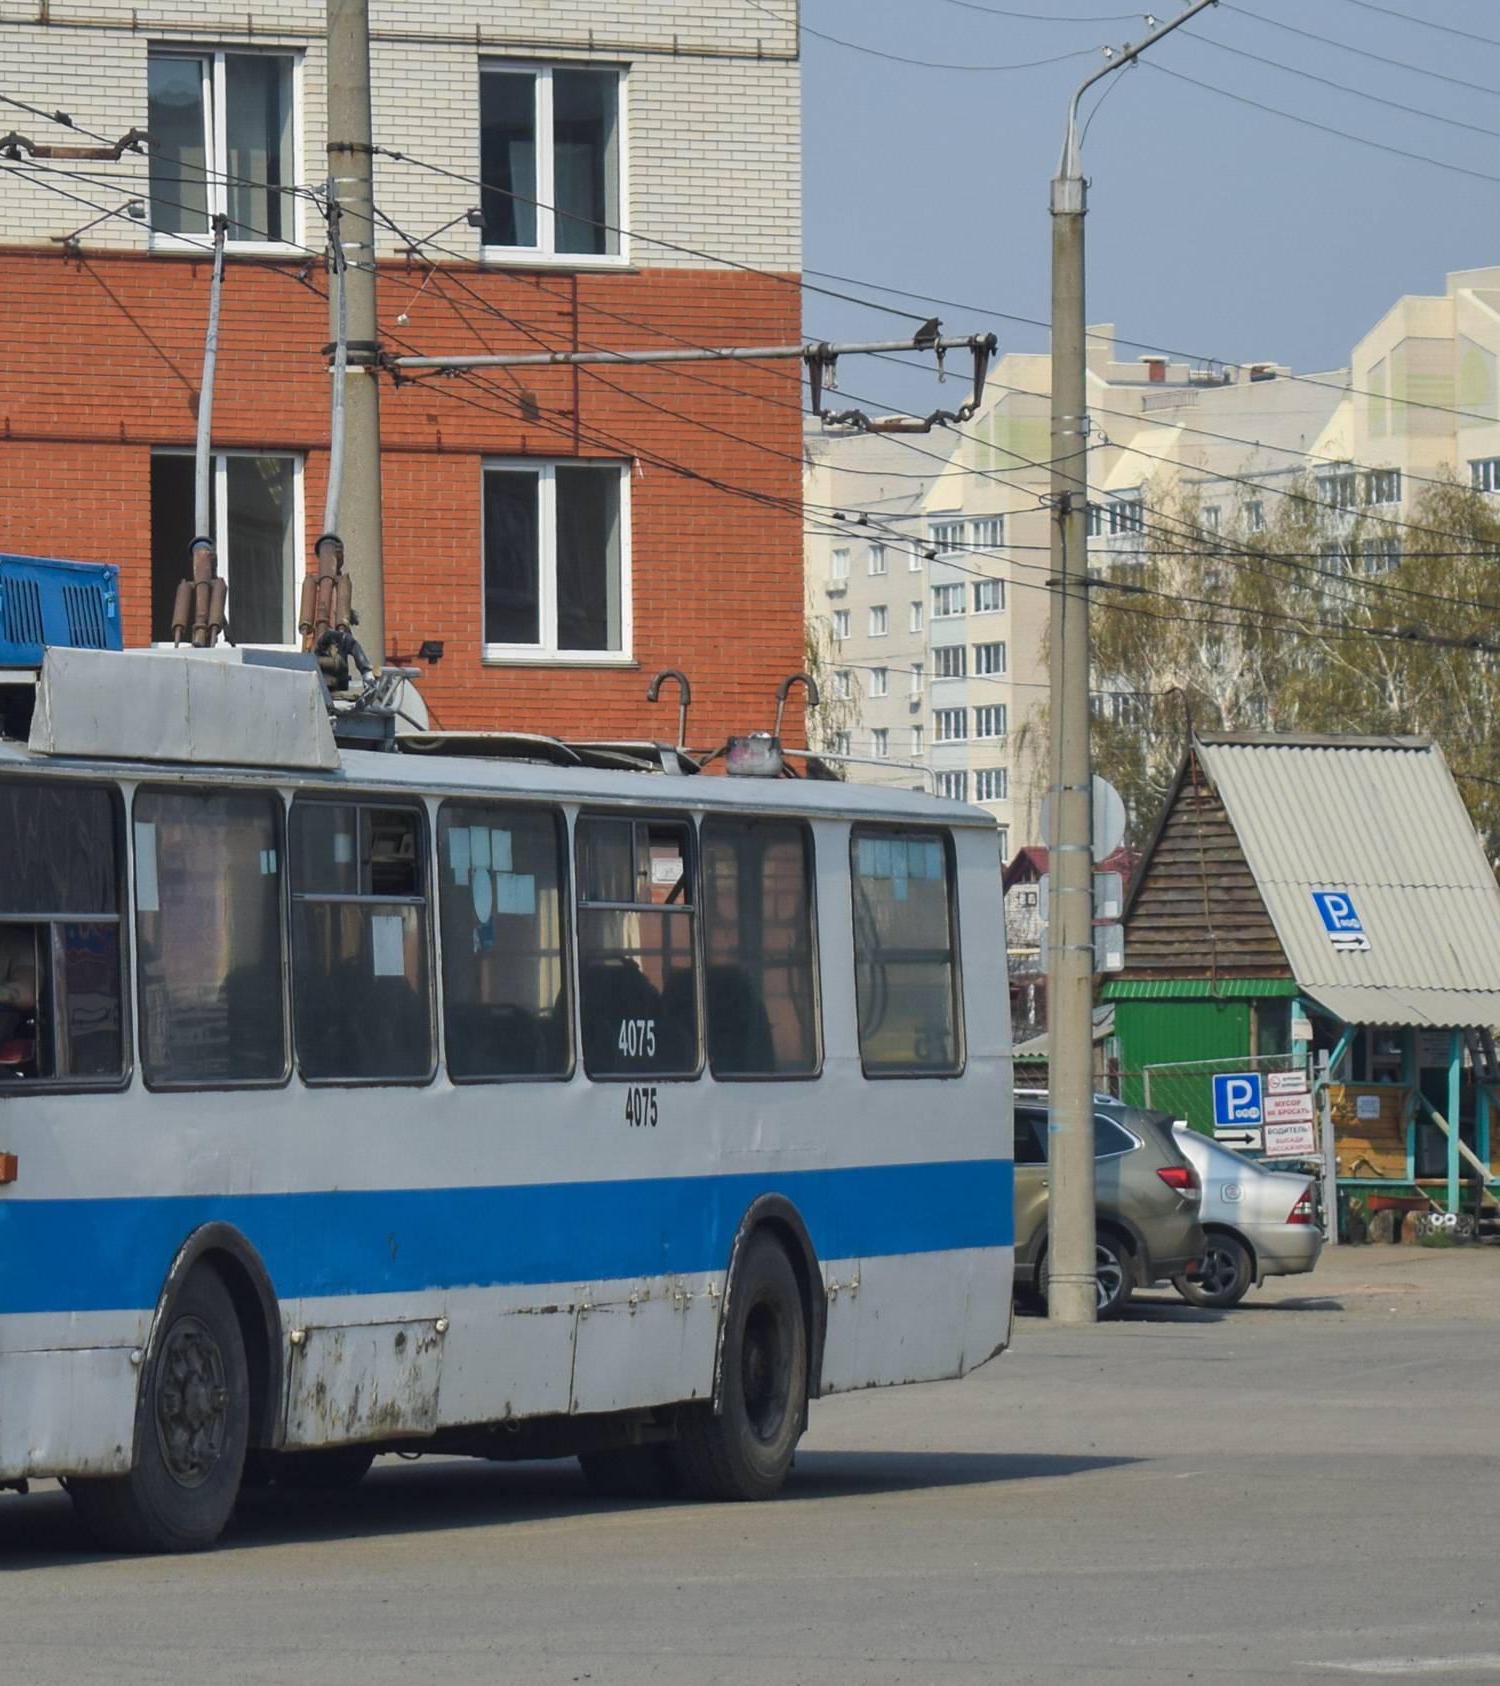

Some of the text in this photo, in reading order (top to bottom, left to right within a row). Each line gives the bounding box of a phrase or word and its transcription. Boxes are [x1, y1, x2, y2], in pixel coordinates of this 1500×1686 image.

[1323, 895, 1349, 928] P
[619, 1019, 656, 1056] 4075
[625, 1087, 658, 1128] 4075
[1226, 1079, 1253, 1121] P
